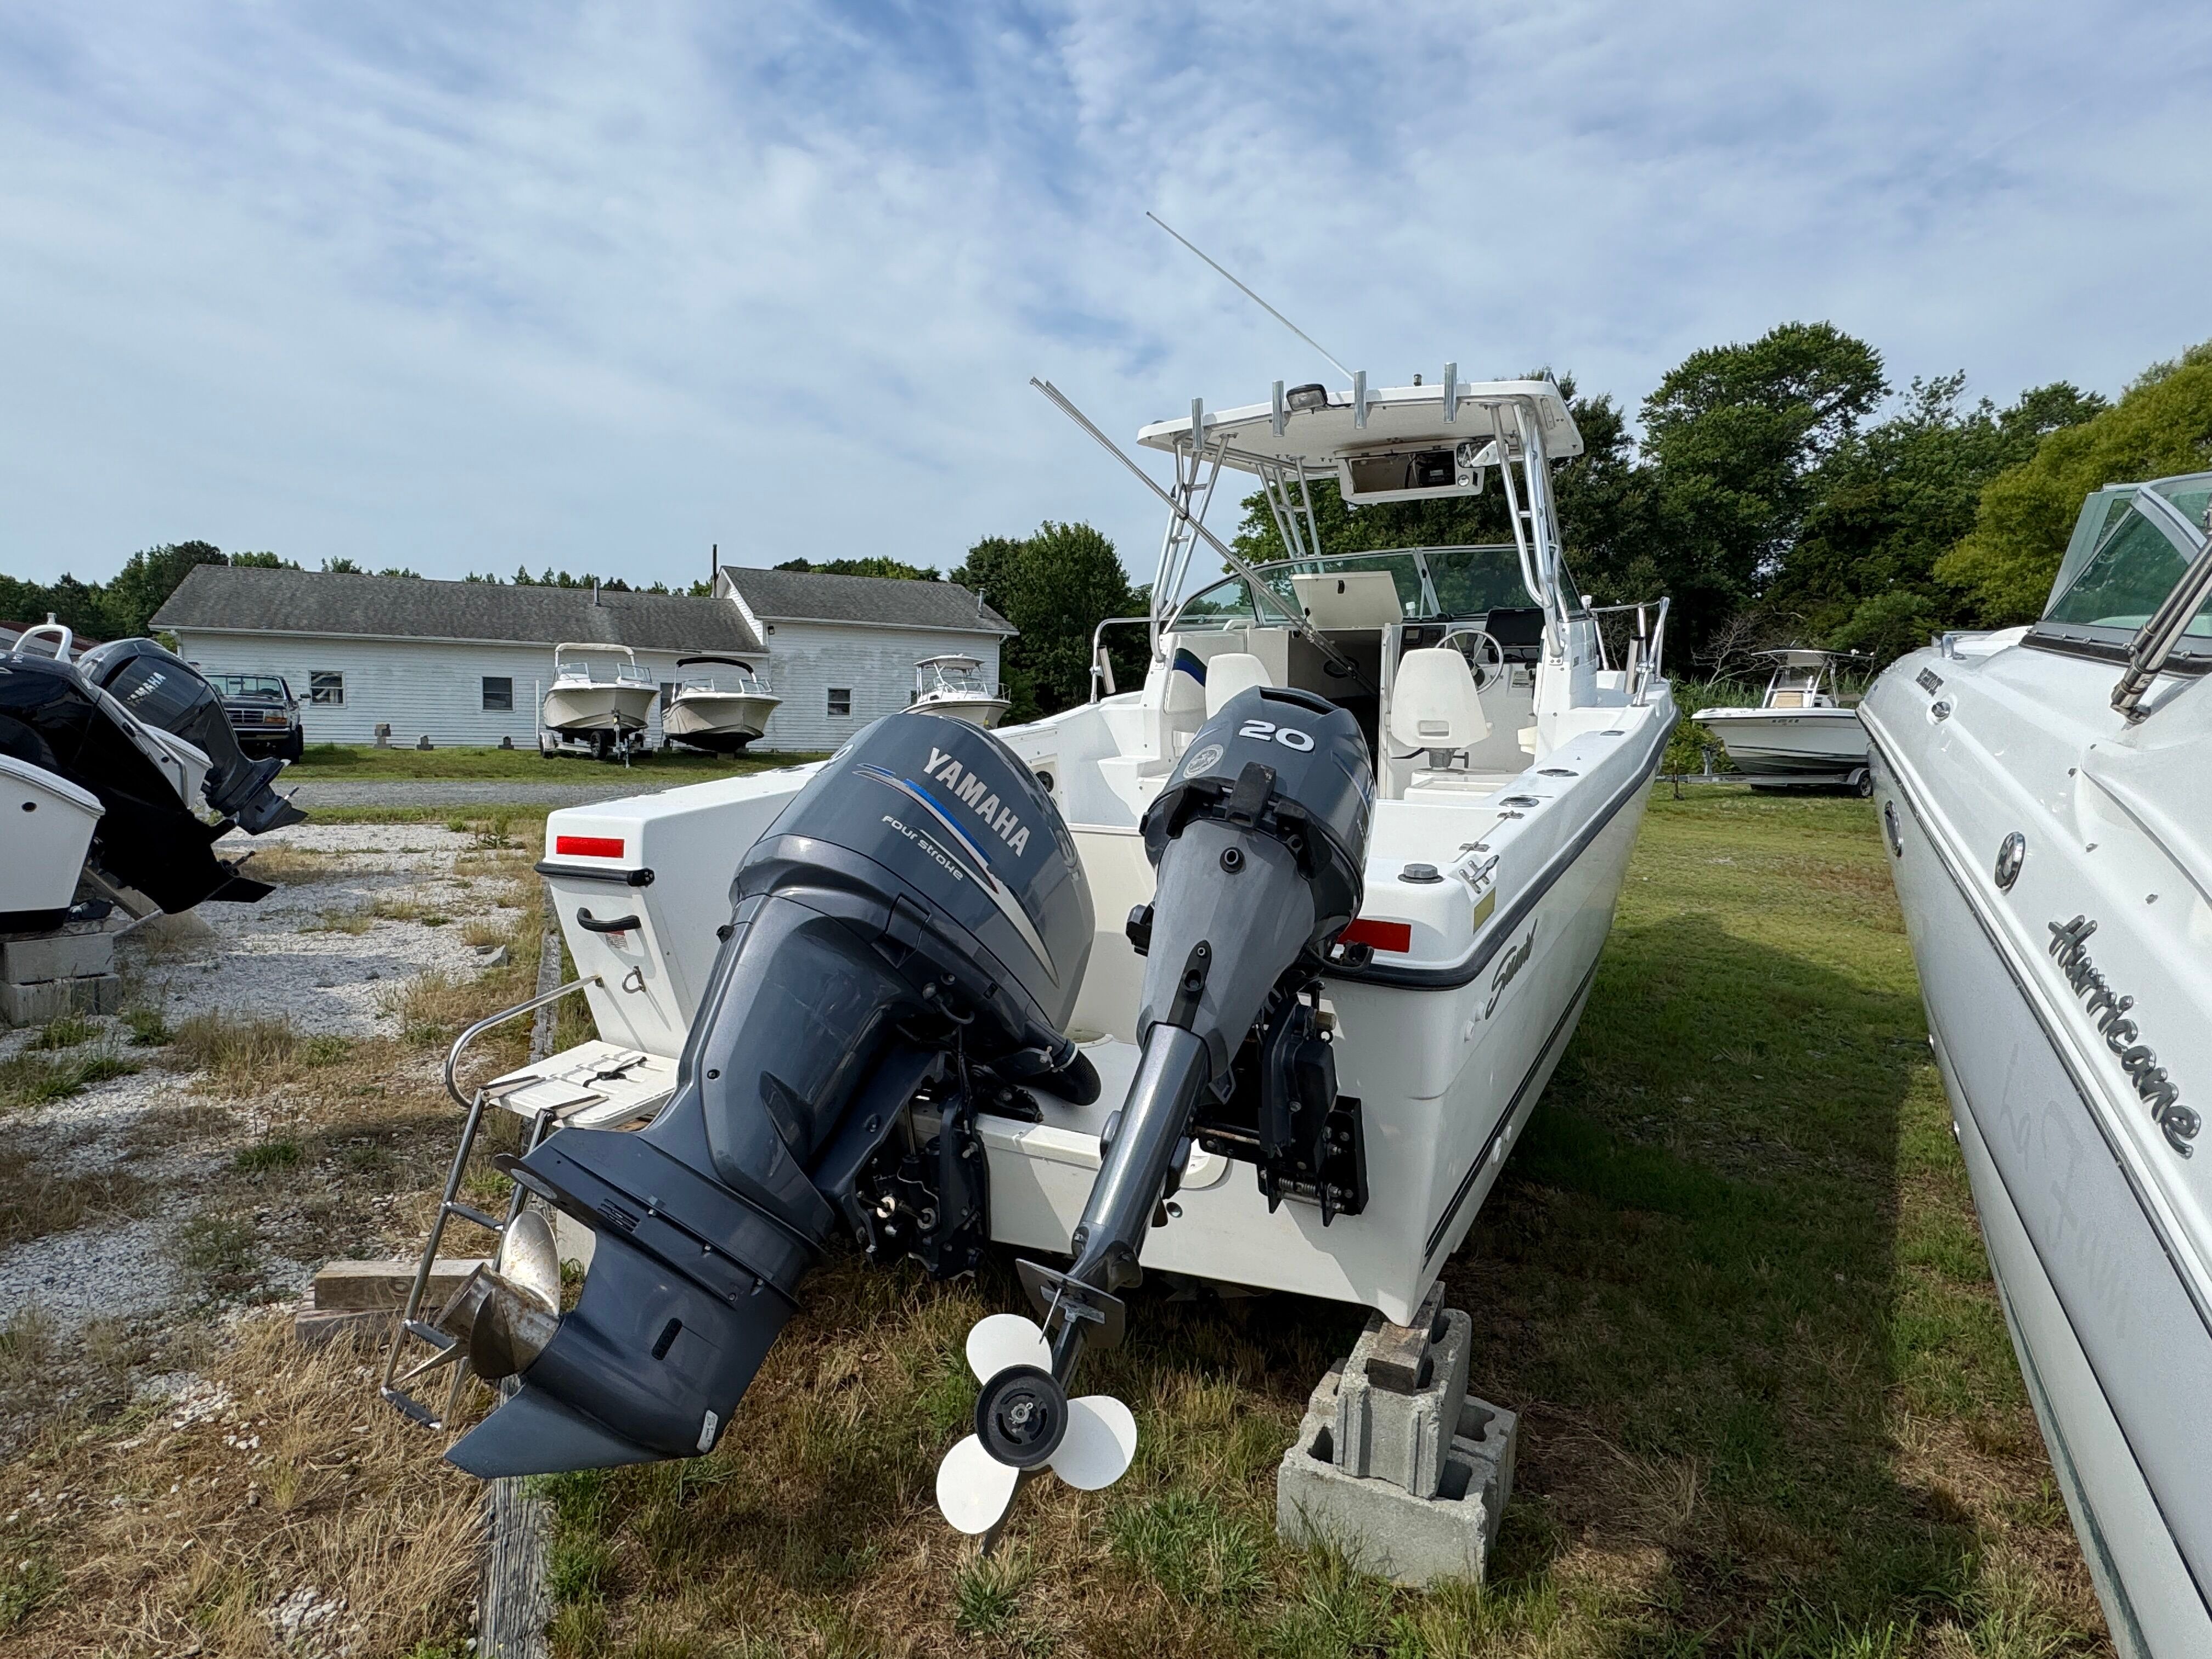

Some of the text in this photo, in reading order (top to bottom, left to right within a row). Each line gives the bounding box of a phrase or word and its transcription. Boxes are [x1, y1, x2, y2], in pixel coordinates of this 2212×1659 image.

[125, 672, 167, 707] YAMAHA
[1239, 720, 1314, 752] 20
[923, 747, 1030, 857] YAMAHA
[2048, 915, 2201, 1159] Hurricane
